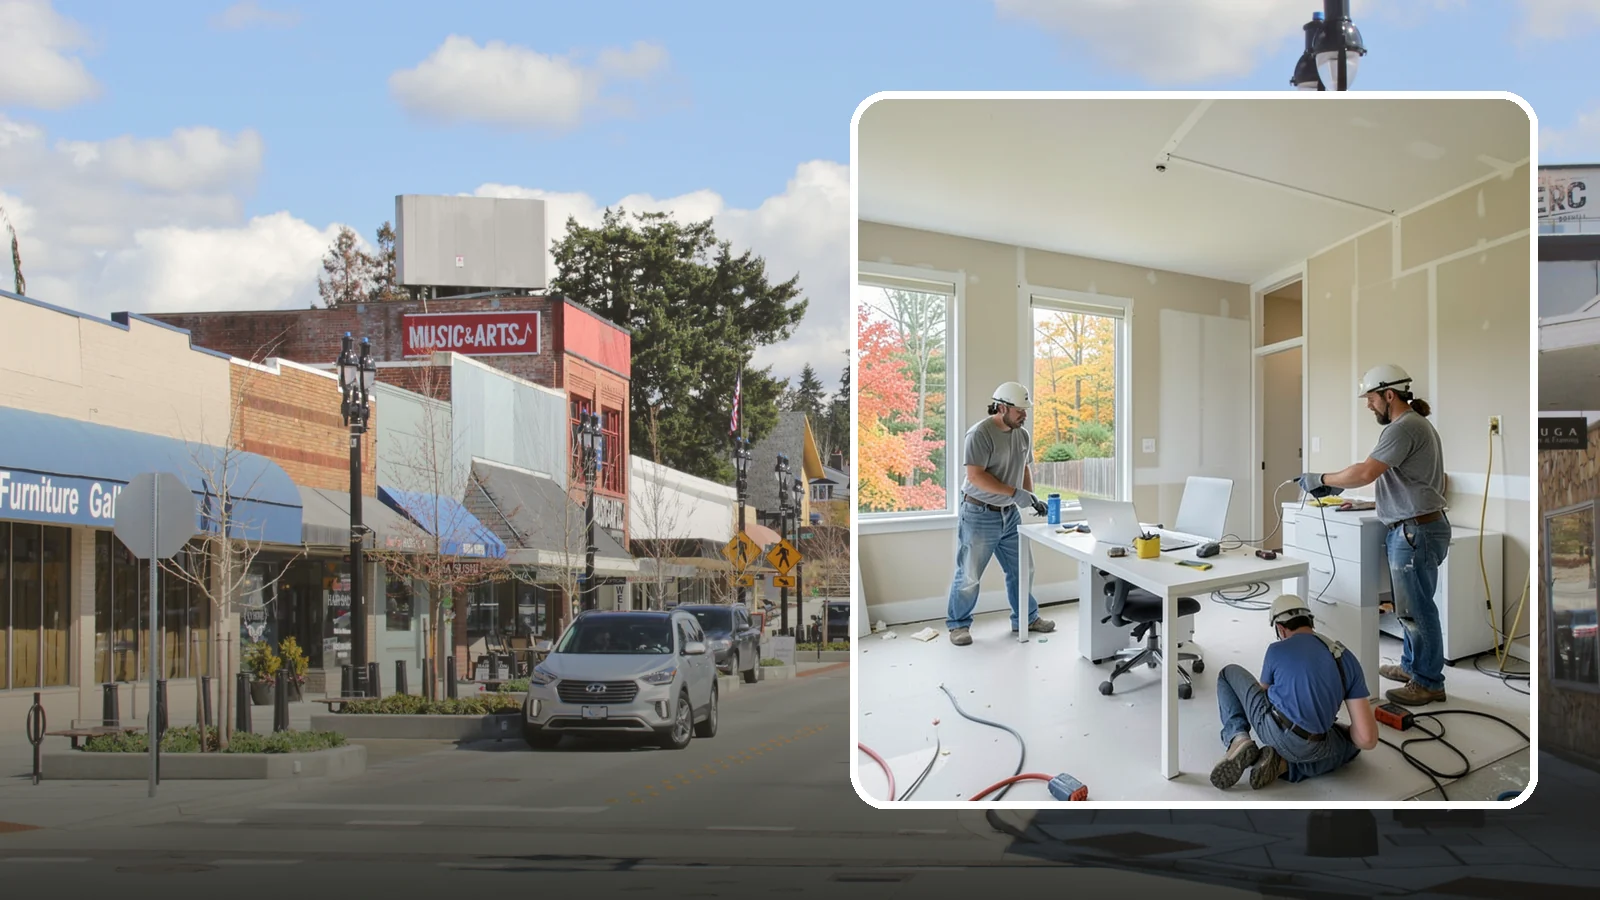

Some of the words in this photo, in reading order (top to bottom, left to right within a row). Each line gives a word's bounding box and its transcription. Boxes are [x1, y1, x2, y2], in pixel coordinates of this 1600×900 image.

[1540, 427, 1578, 437] UGA
[0, 471, 79, 515] Furniture
[89, 482, 122, 519] Gal
[453, 563, 479, 574] SUSHI
